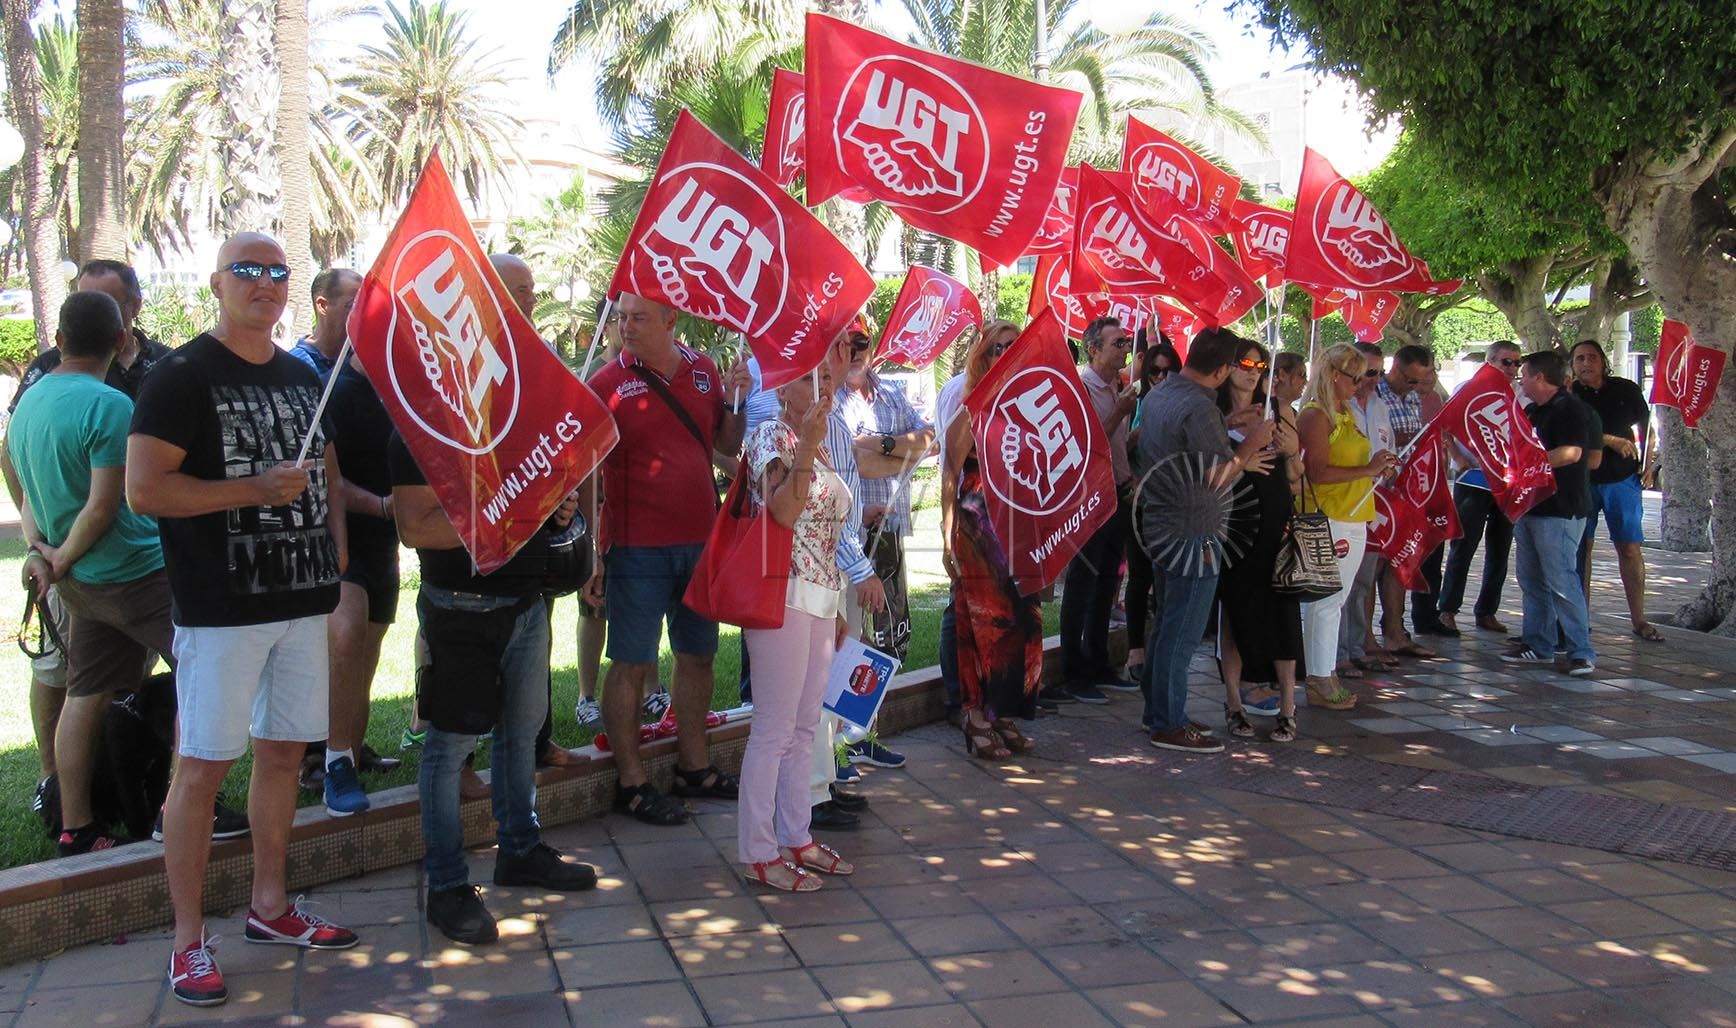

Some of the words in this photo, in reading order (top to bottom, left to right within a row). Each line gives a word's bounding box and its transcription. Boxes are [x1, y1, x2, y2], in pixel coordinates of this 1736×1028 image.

[858, 69, 970, 174] UGT
[983, 109, 1046, 239] www.ugt.es
[1138, 149, 1194, 204] UGT
[657, 176, 776, 306] UGT
[1248, 219, 1289, 256] UG
[412, 246, 509, 412] UGT
[481, 409, 584, 526] www.ugt.es
[1016, 377, 1084, 488] UGT
[1028, 490, 1101, 565] www.ugt.es
